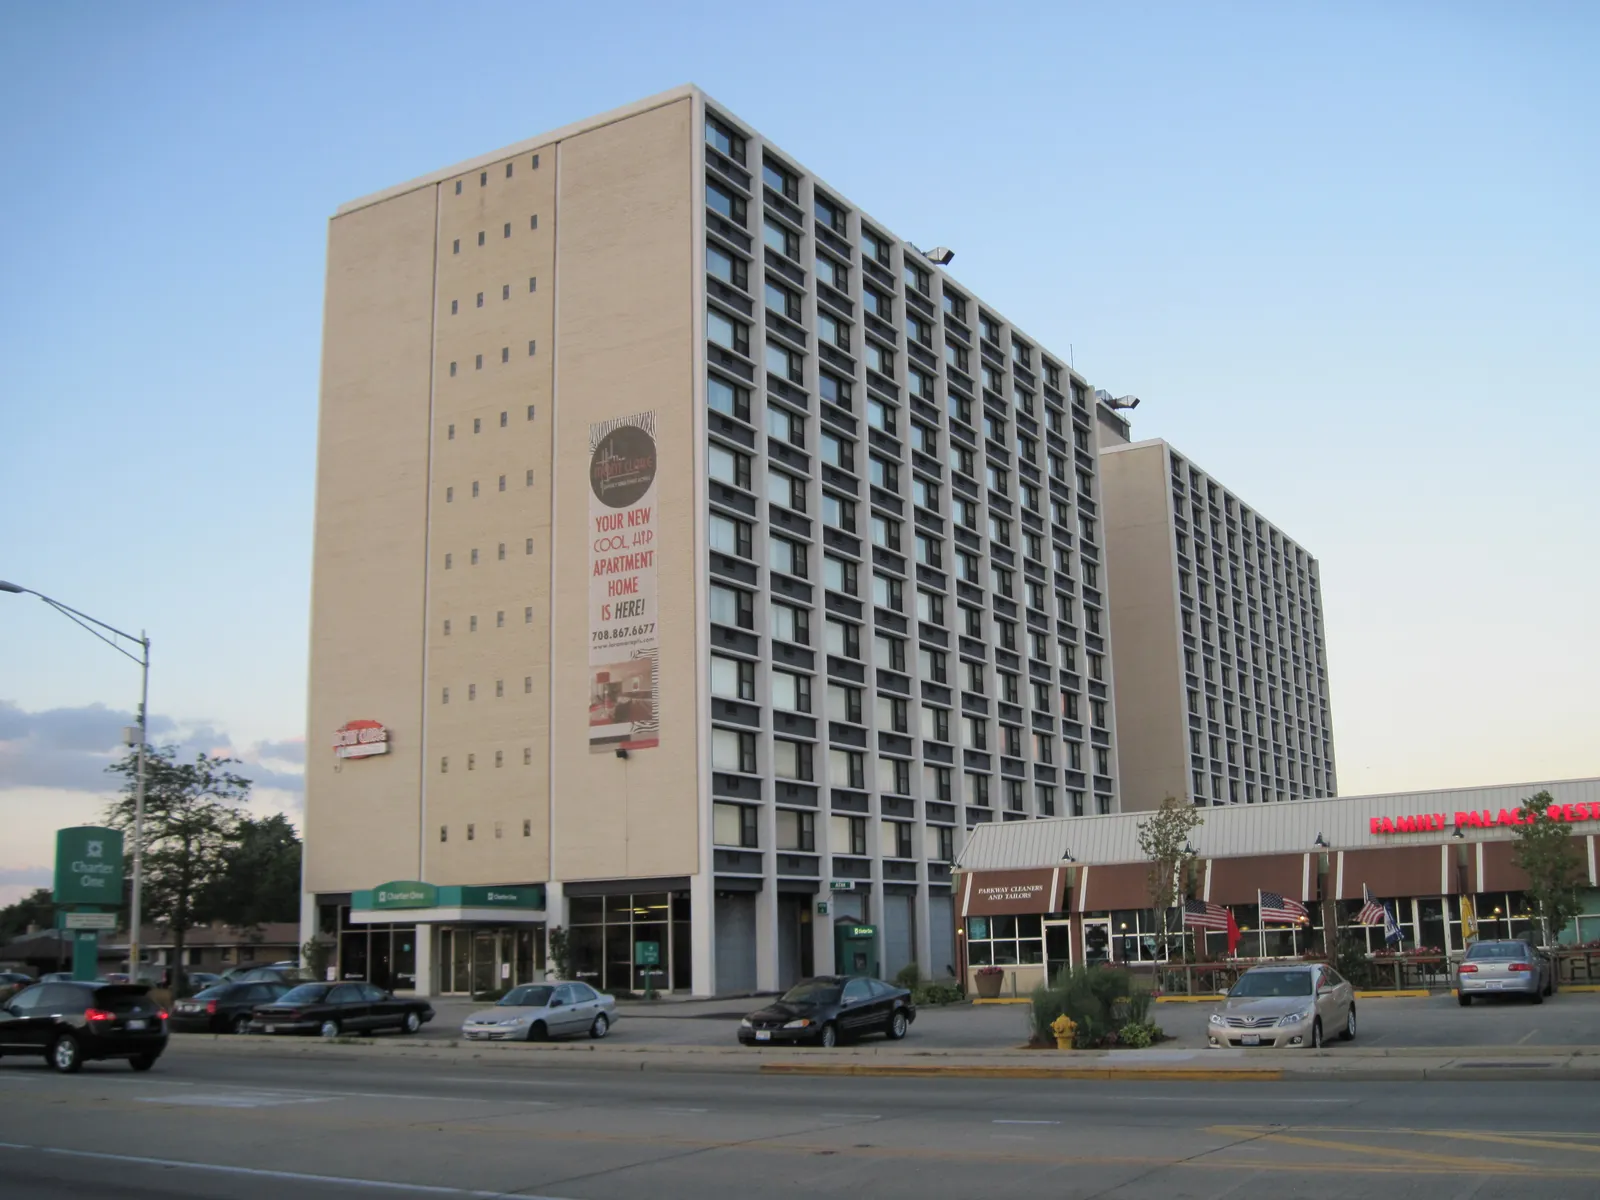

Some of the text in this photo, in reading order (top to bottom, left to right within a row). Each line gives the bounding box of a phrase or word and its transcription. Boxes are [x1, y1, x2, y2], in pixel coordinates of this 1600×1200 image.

[595, 507, 651, 533] YOUR NEW
[632, 530, 653, 547] HIP
[593, 550, 654, 577] APARTMENT
[608, 576, 638, 597] HOME
[601, 598, 645, 621] IS HERE!
[592, 623, 655, 642] 708.867.6677
[1370, 812, 1447, 835] FAMILY
[71, 861, 114, 874] Charter
[81, 875, 105, 887] One
[978, 885, 1043, 895] PARKWAY CLEANERS
[1005, 892, 1032, 900] TAILORS
